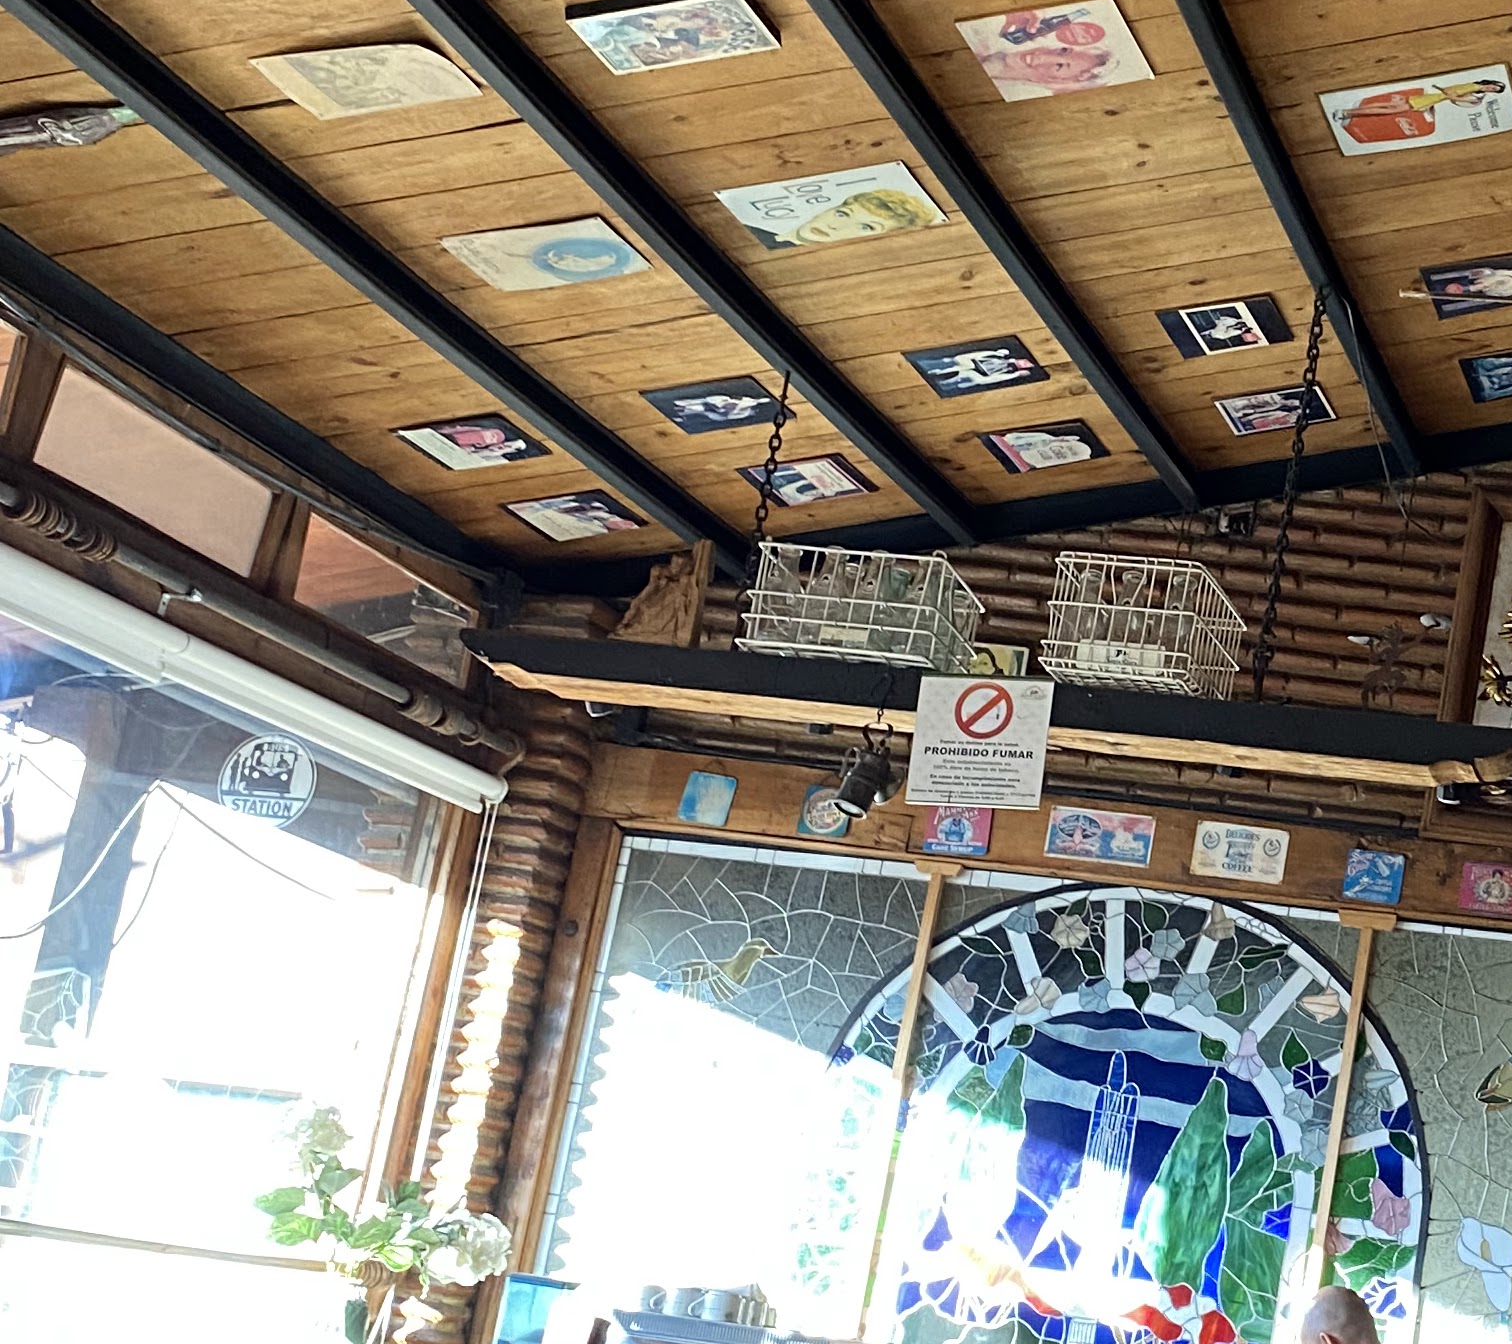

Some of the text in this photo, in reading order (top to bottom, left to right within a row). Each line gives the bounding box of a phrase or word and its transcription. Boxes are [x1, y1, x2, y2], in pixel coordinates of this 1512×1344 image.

[924, 746, 1034, 760] PROHIBIDO FUMAR
[231, 797, 293, 817] STATION
